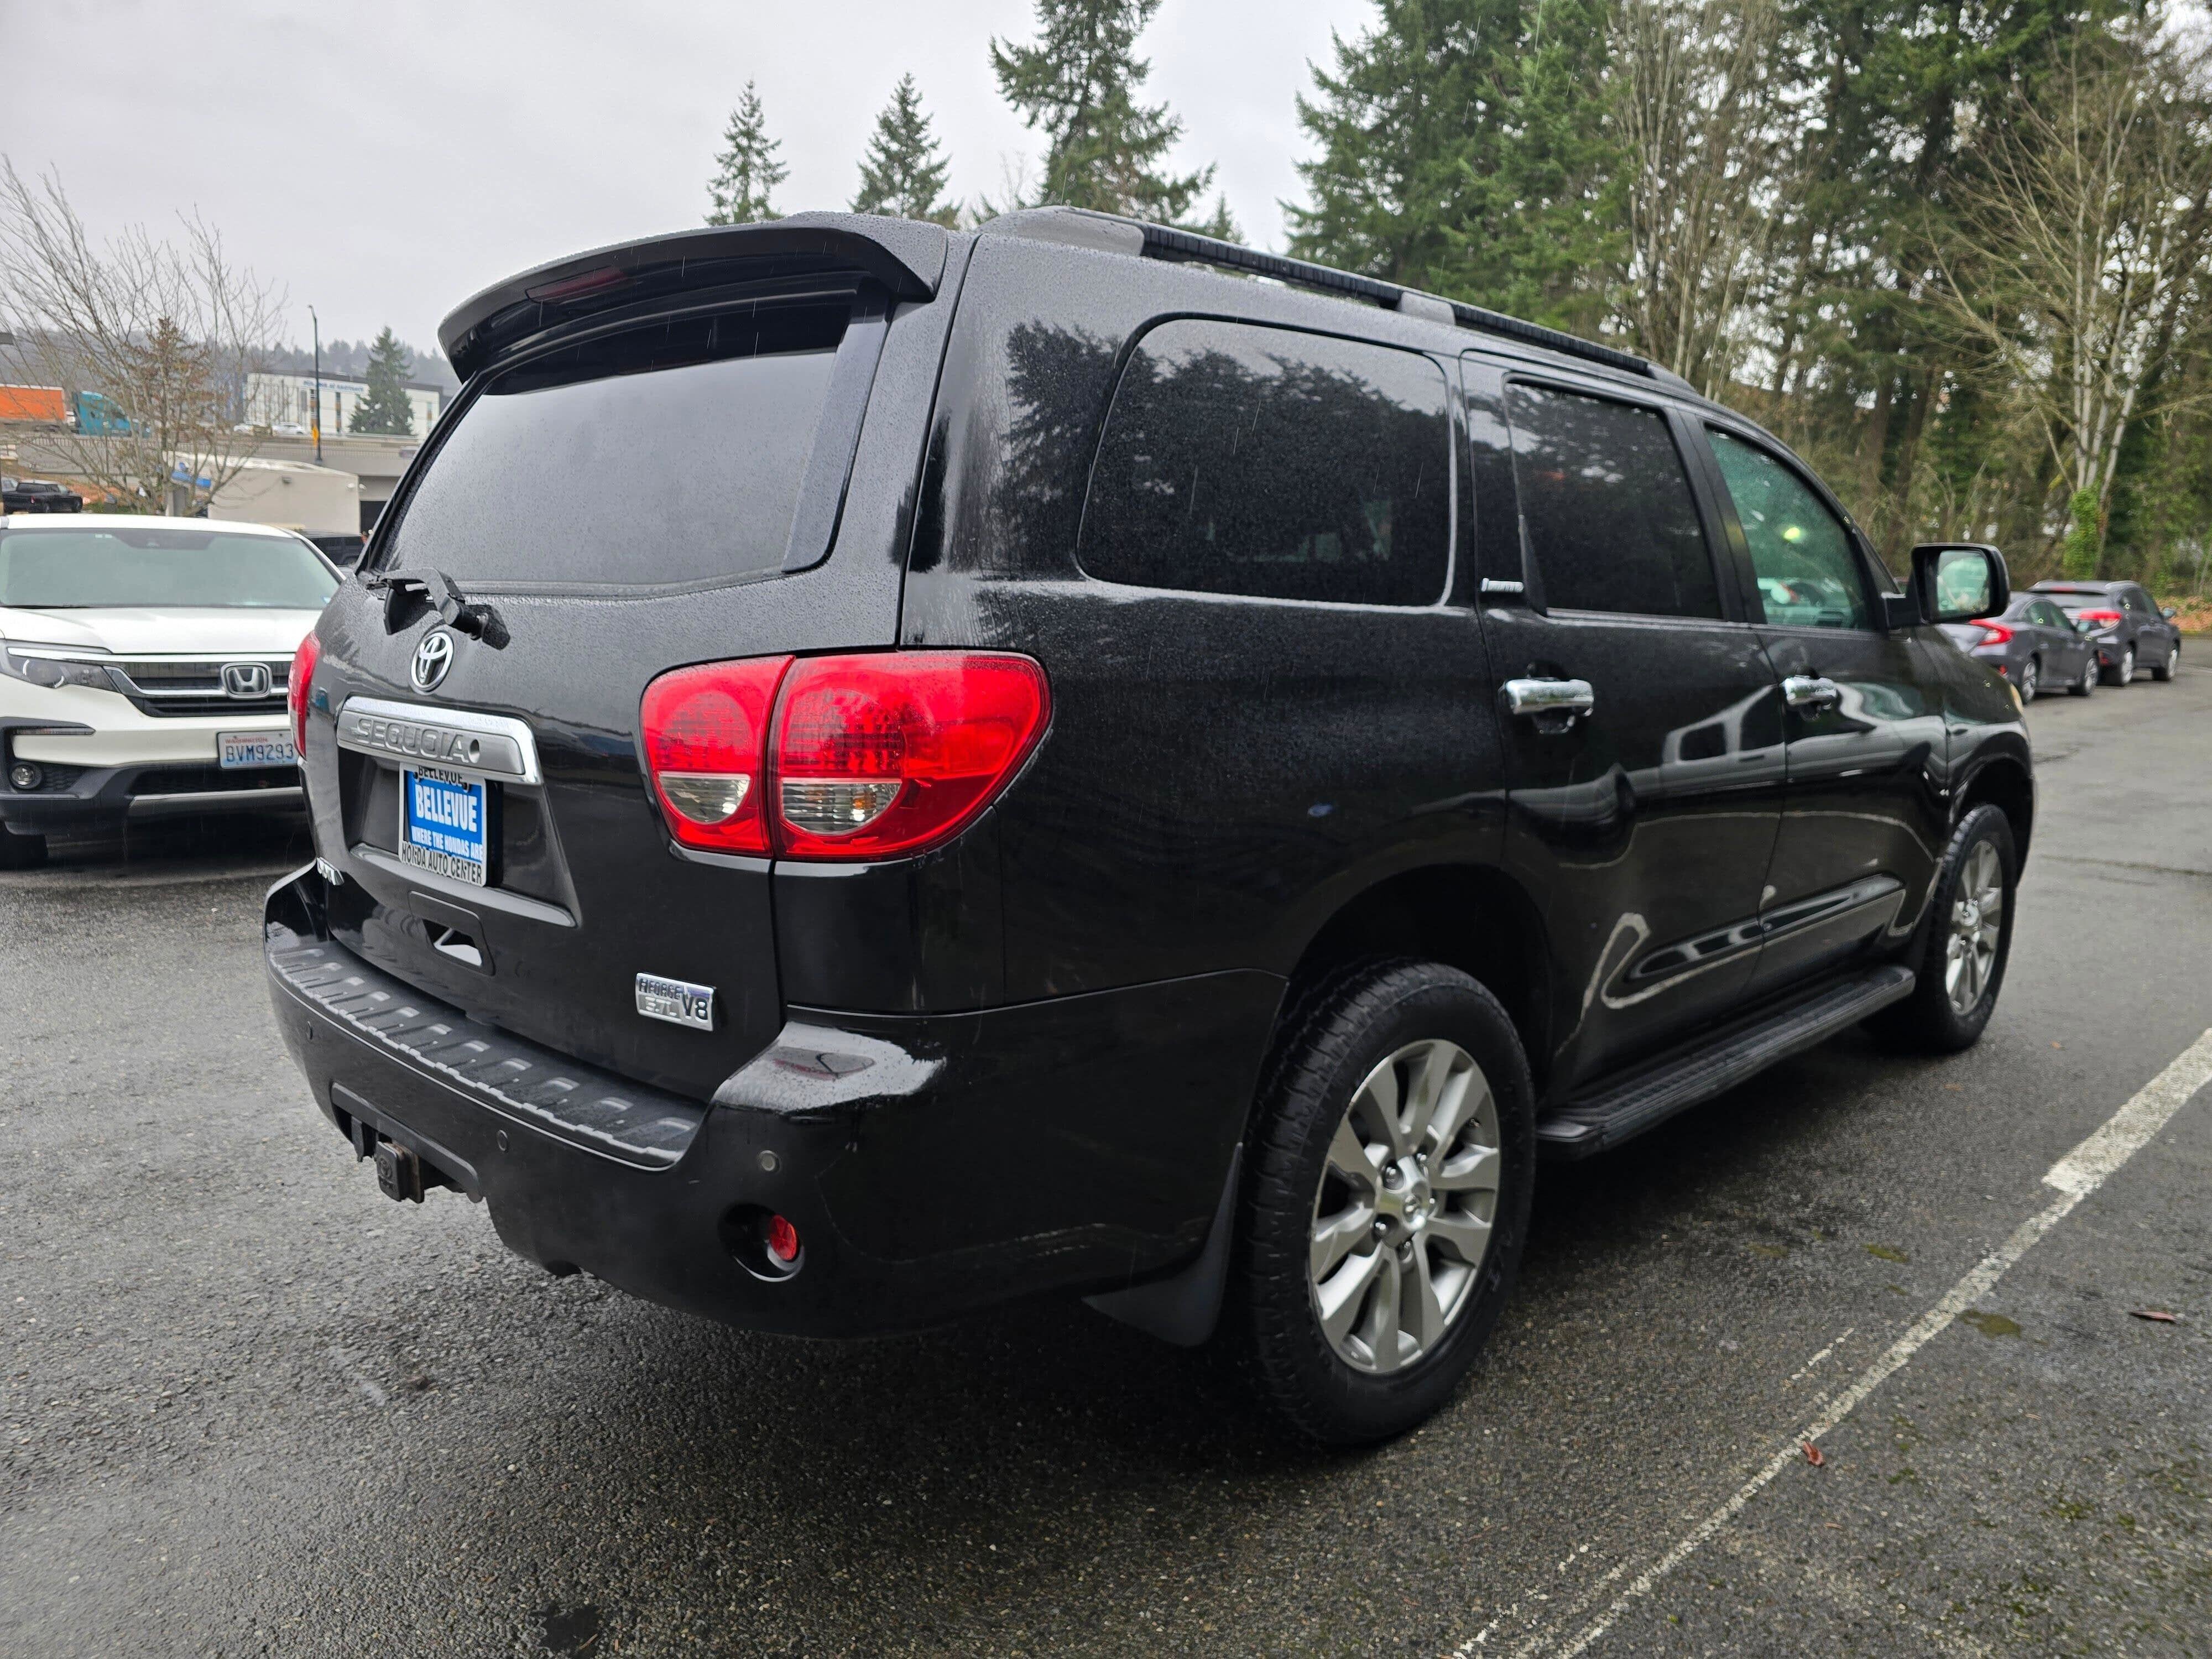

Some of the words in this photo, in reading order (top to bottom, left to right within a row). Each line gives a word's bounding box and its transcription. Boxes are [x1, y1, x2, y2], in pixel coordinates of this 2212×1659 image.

[226, 743, 294, 762] BVM9293
[356, 718, 469, 764] SEQUOIA
[418, 765, 463, 785] BELLEVUE
[415, 784, 477, 833] BELLEVUE
[411, 825, 432, 847] WHERE
[432, 831, 444, 850] THE
[444, 834, 469, 858] HONDAS
[470, 841, 483, 862] ARE
[401, 842, 427, 868] HONDA
[428, 850, 448, 874] AUTO
[450, 857, 482, 885] CENTER
[681, 985, 708, 1020] V8
